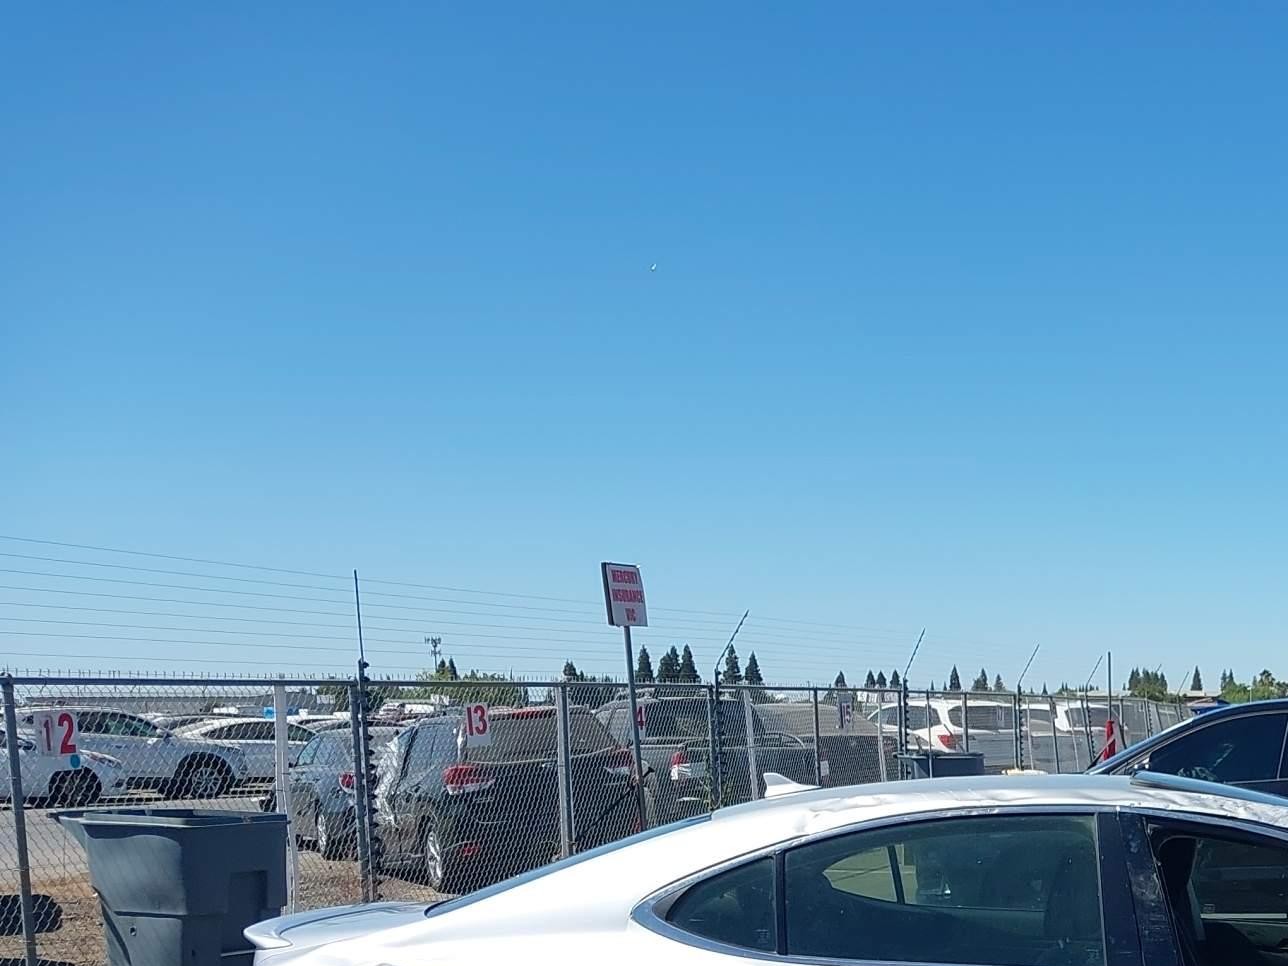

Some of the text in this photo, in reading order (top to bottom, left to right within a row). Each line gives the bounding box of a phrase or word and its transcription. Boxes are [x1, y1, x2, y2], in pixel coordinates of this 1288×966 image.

[612, 588, 644, 604] INSURANCE
[43, 713, 77, 755] 12
[467, 704, 488, 735] 13
